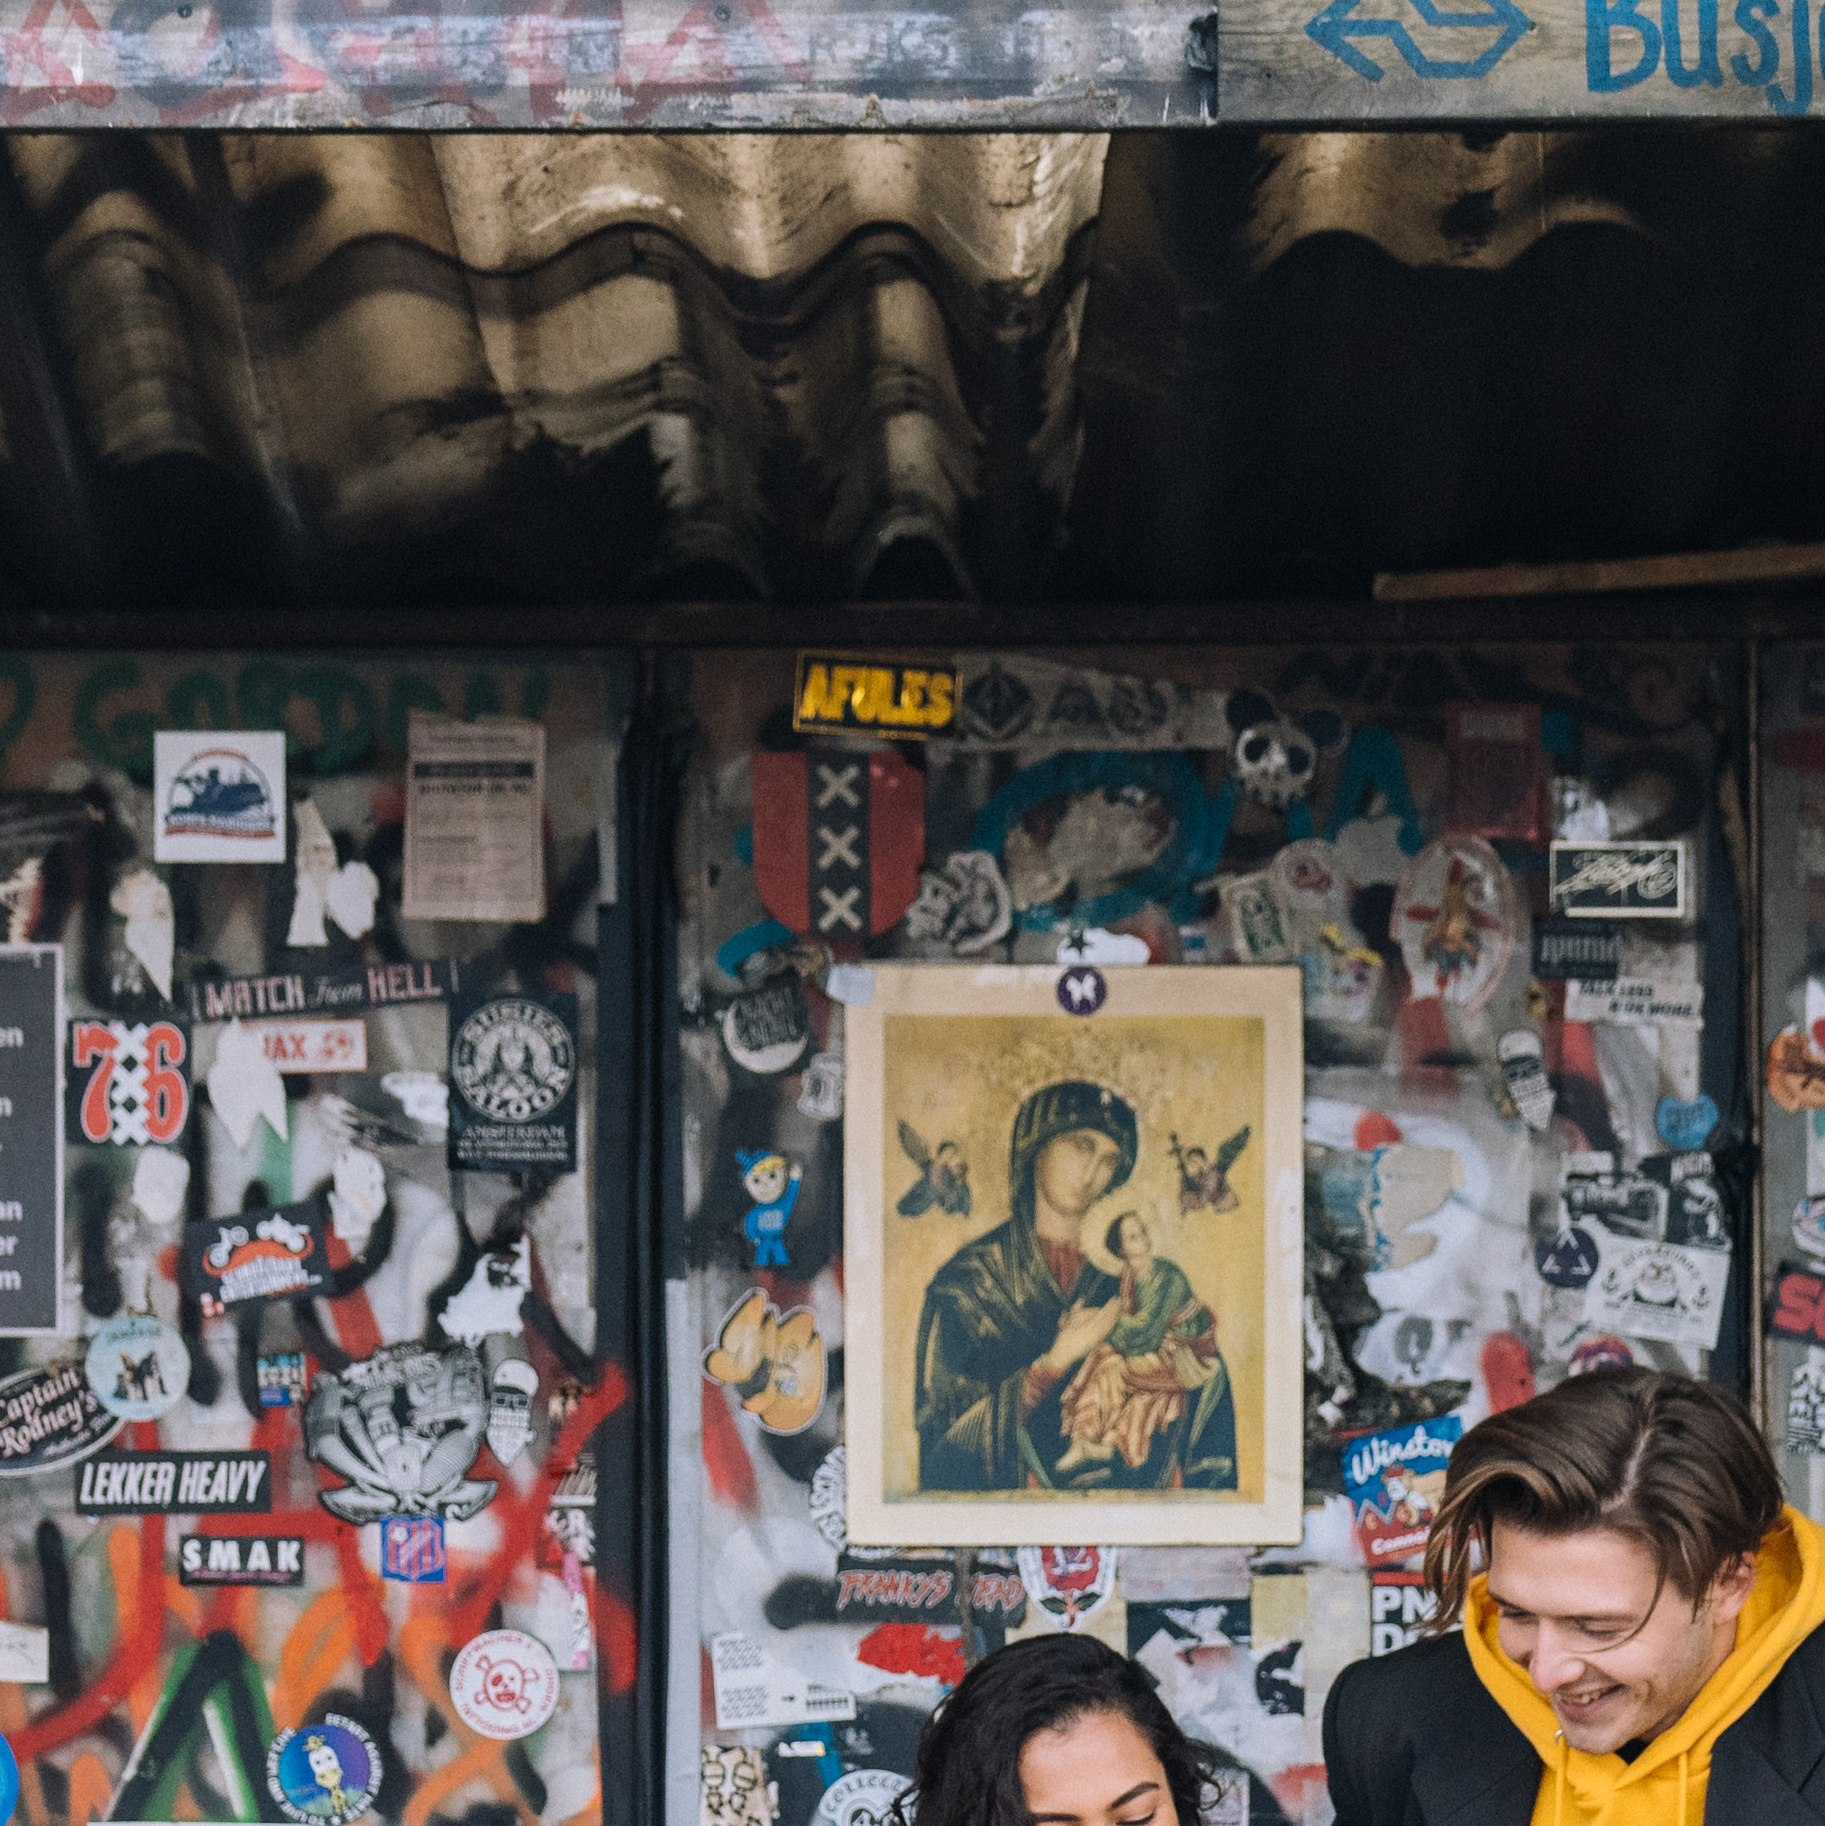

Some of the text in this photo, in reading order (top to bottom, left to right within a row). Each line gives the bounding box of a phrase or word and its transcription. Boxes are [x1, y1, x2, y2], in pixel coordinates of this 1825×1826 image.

[79, 1460, 267, 1505] LEKKER HEAVY
[182, 1539, 301, 1573] SMAK
[955, 1572, 1024, 1612] EAD
